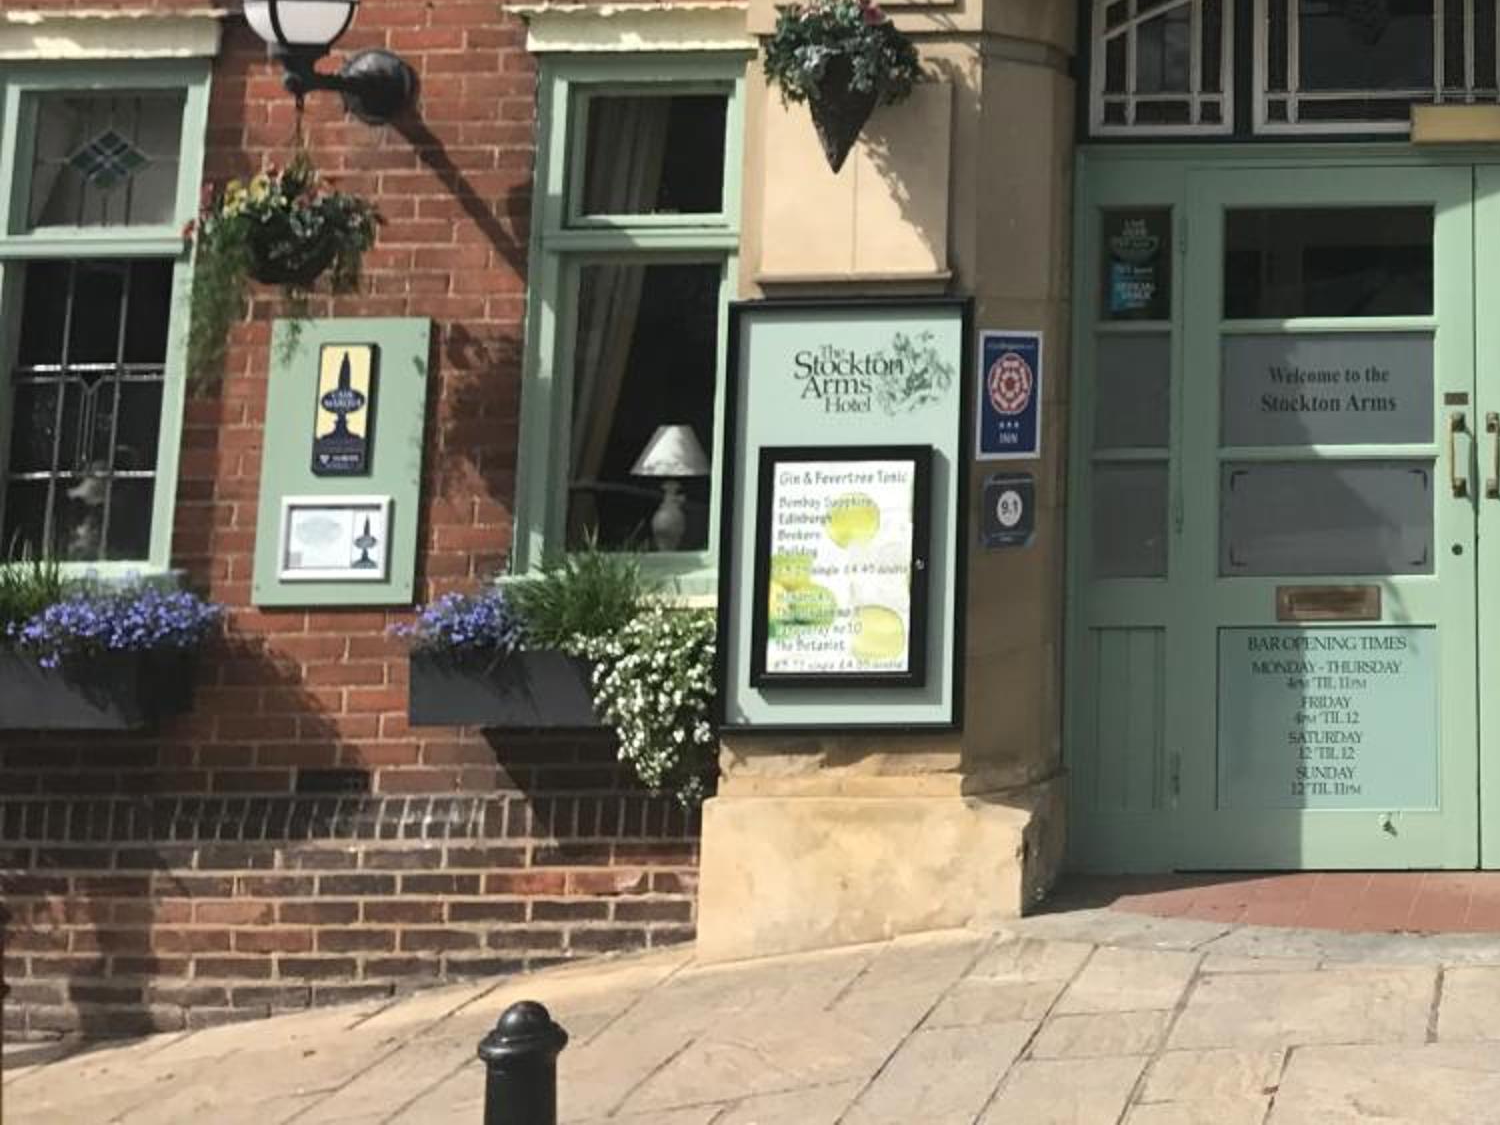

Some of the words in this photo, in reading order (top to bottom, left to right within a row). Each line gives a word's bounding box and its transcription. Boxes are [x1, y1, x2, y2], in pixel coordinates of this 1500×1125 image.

[819, 343, 845, 359] The
[793, 350, 904, 379] Stockton
[1268, 365, 1341, 383] Welcome
[1345, 367, 1360, 382] to
[1365, 365, 1390, 382] the
[800, 376, 872, 399] Arms
[825, 396, 871, 412] Hotel
[1261, 394, 1340, 412] Stockton
[1346, 394, 1397, 412] Arms
[1248, 637, 1281, 651] BAR
[1282, 636, 1357, 651] OPENING
[1361, 636, 1407, 651] TIMES
[1251, 661, 1315, 674] MONDAY
[1327, 660, 1402, 674] THURSDAY
[1300, 696, 1352, 709] FRIDAY
[1346, 712, 1360, 724] 12
[1288, 731, 1362, 744] SATURDAY
[1296, 767, 1355, 779] SUNDAY
